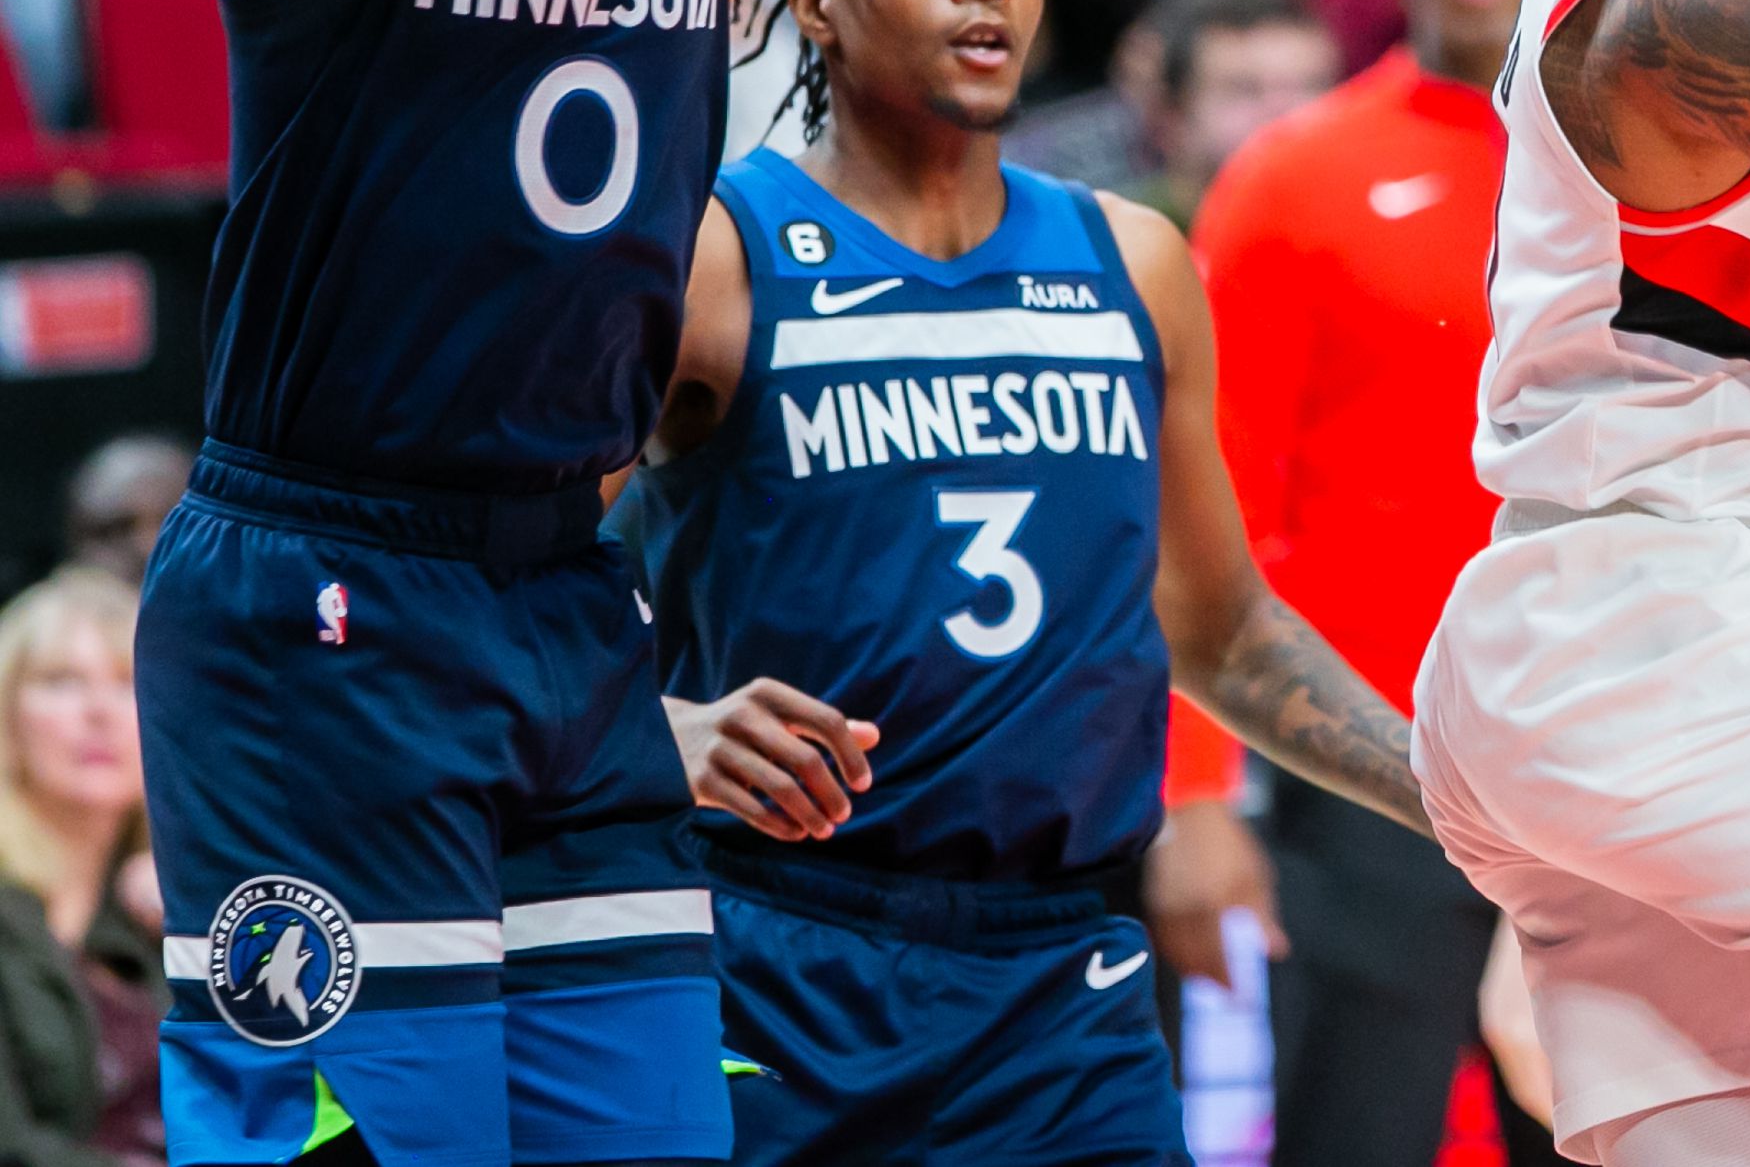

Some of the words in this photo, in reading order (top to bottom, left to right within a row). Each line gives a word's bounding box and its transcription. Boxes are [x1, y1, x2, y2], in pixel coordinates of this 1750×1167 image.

[514, 58, 640, 235] 0
[786, 222, 827, 264] 6
[780, 370, 1148, 479] MINNESOTA
[937, 490, 1043, 658] 3
[212, 887, 268, 987] MINNESOTA
[273, 884, 354, 1014] TIMBERWOLVES
